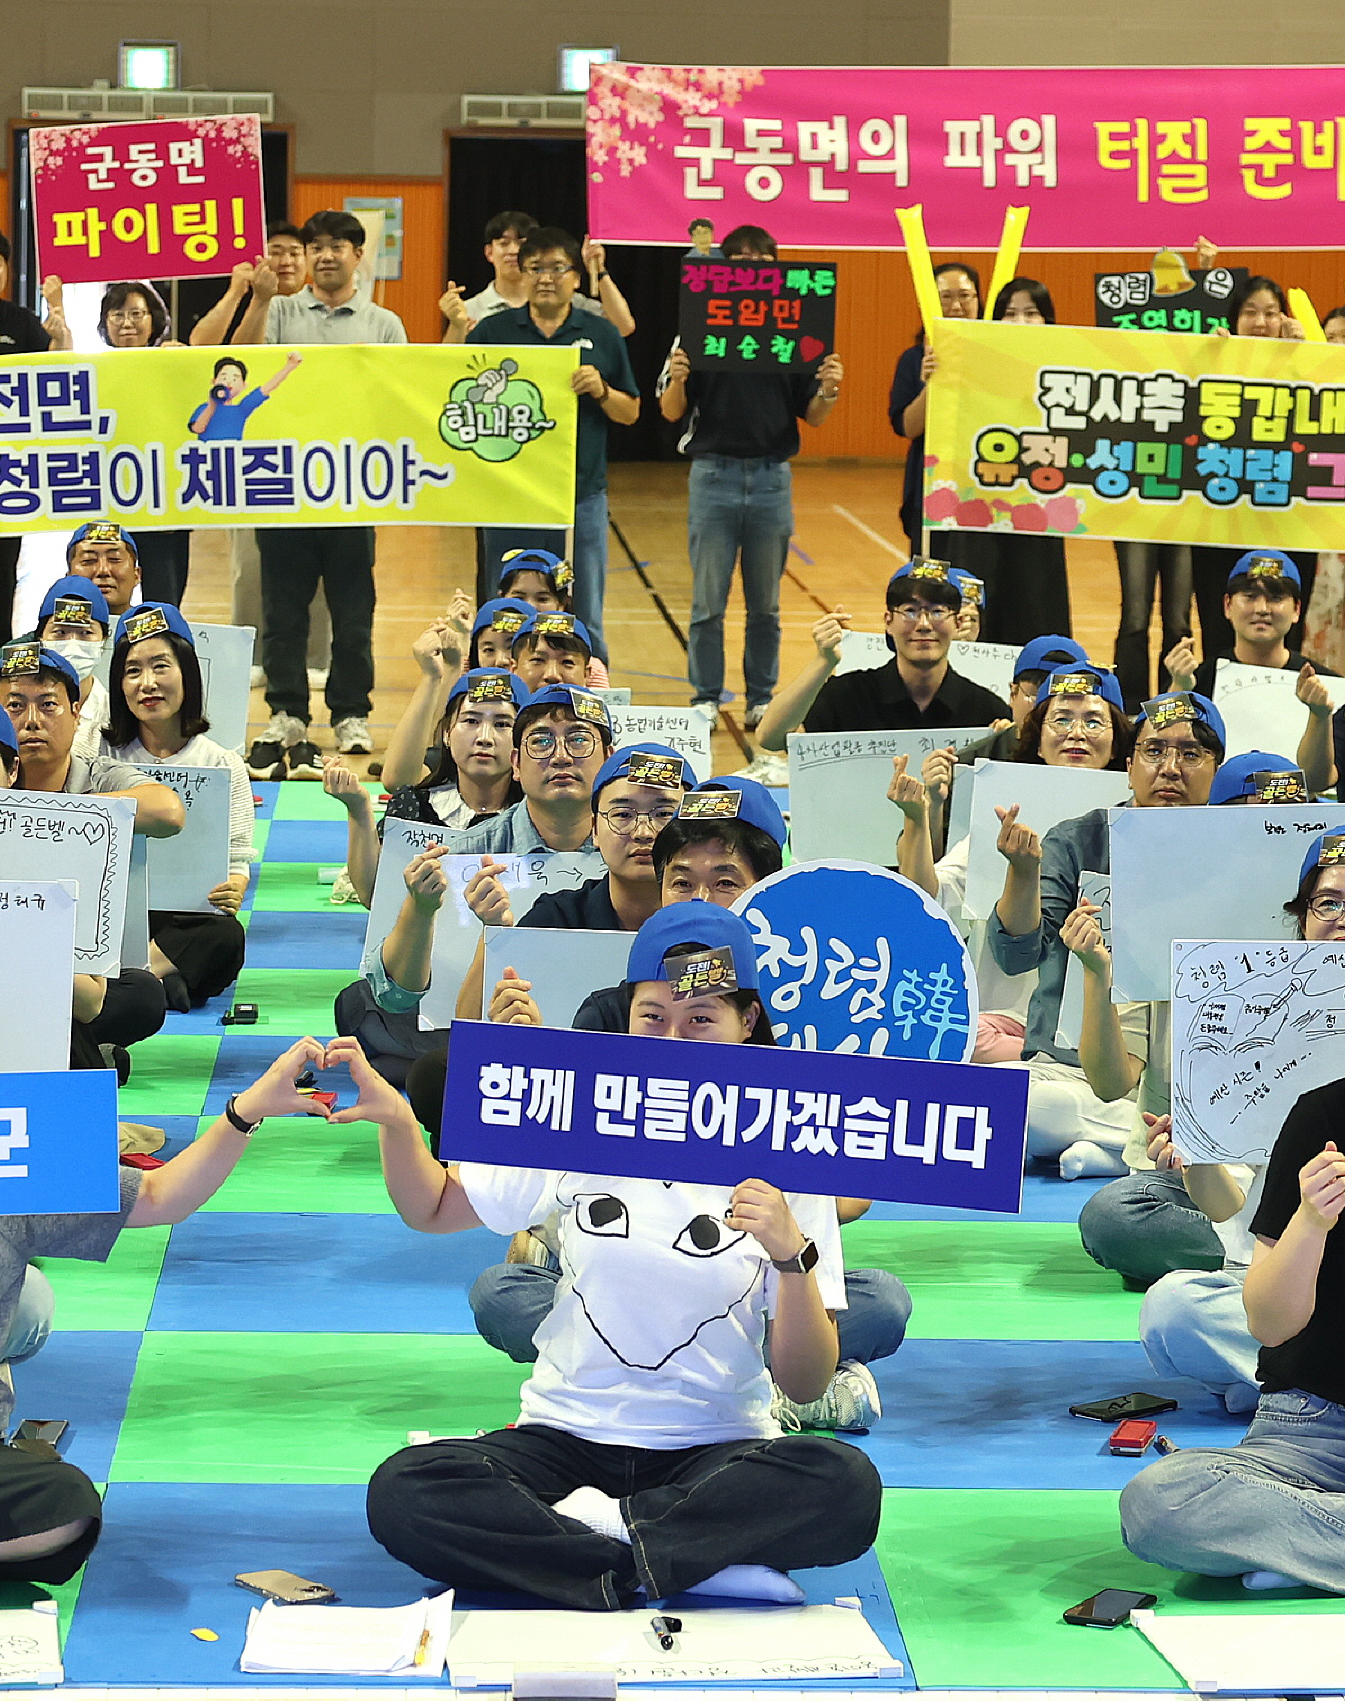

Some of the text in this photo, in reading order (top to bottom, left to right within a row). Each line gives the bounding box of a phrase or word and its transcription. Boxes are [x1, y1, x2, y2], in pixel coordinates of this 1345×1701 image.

[80, 138, 206, 191] 군동면
[673, 114, 909, 202] 군동면의
[944, 114, 1058, 188] 파워
[1093, 117, 1210, 203] 터질
[52, 198, 246, 262] 파이팅!
[706, 299, 802, 329] 도암면
[1040, 372, 1186, 432] 전사추
[182, 445, 448, 506] 체질이야~
[1195, 443, 1293, 505] 청렴
[479, 1062, 993, 1169] 함께 만들어가겠습니다
